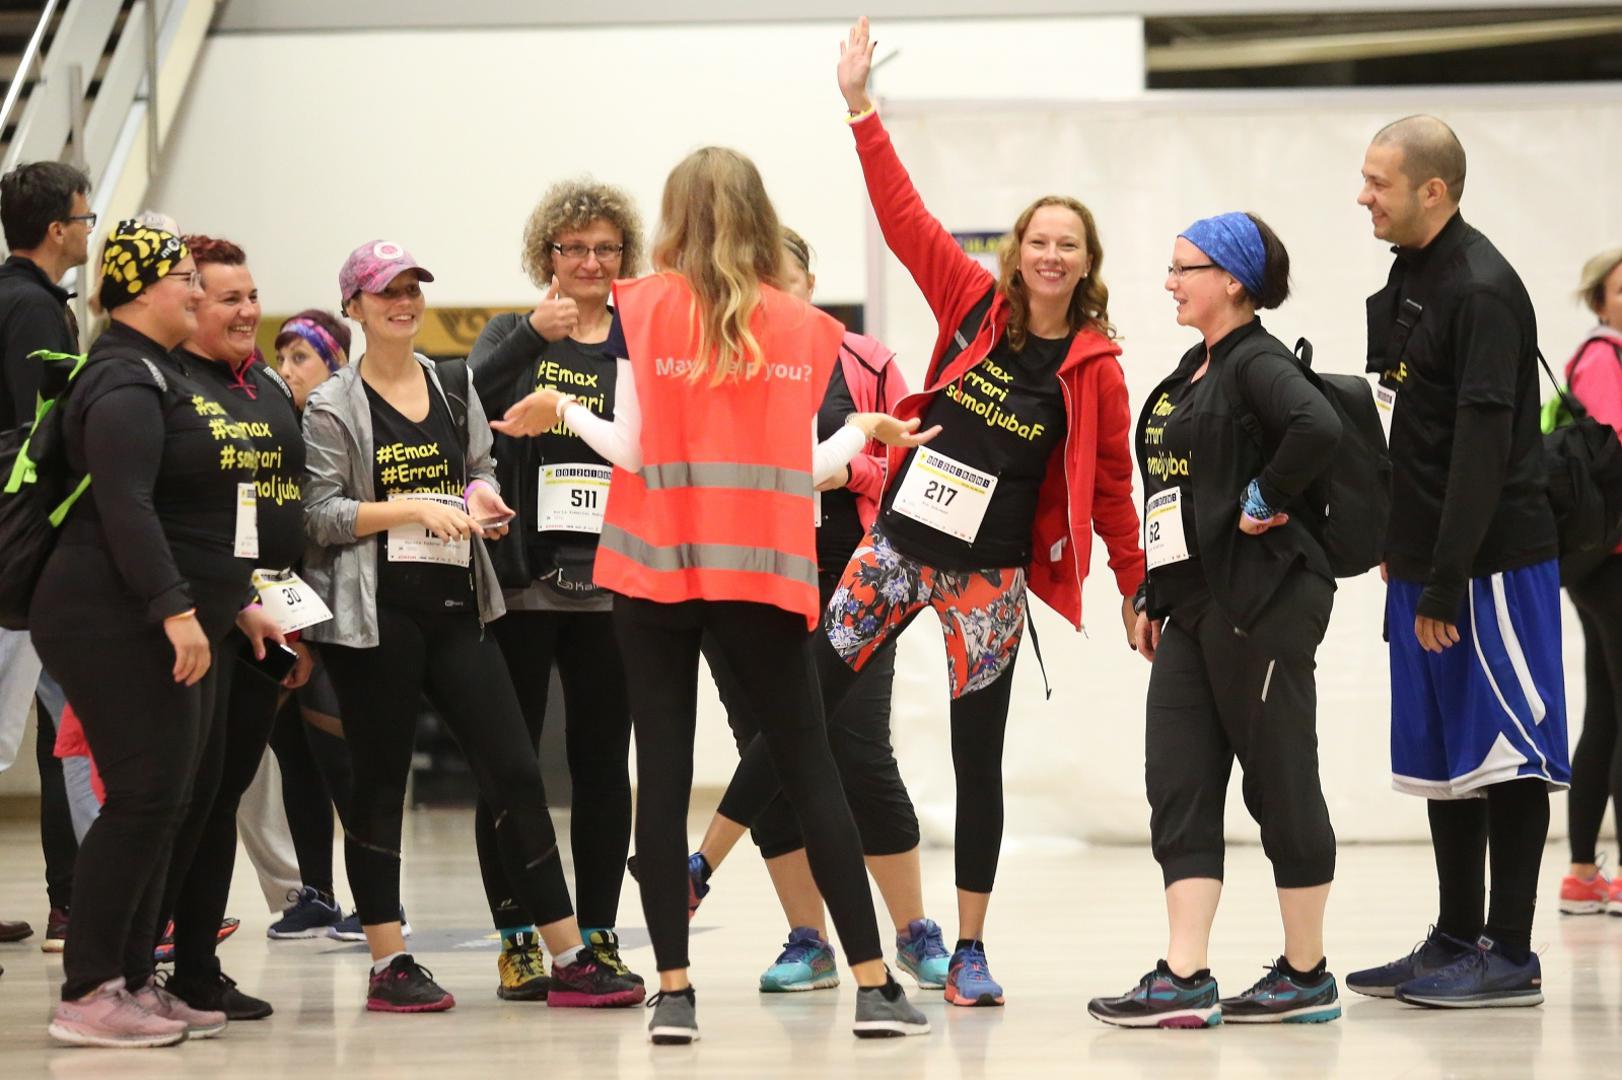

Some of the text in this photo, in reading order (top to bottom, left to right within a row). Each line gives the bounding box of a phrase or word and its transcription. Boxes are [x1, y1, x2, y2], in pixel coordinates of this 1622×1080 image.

[764, 362, 813, 383] you?
[945, 383, 1045, 441] samoljubaF
[376, 442, 440, 465] #Emax
[381, 458, 448, 486] #Errari
[570, 488, 598, 509] 511
[923, 480, 959, 507] 217
[282, 587, 302, 606] 30
